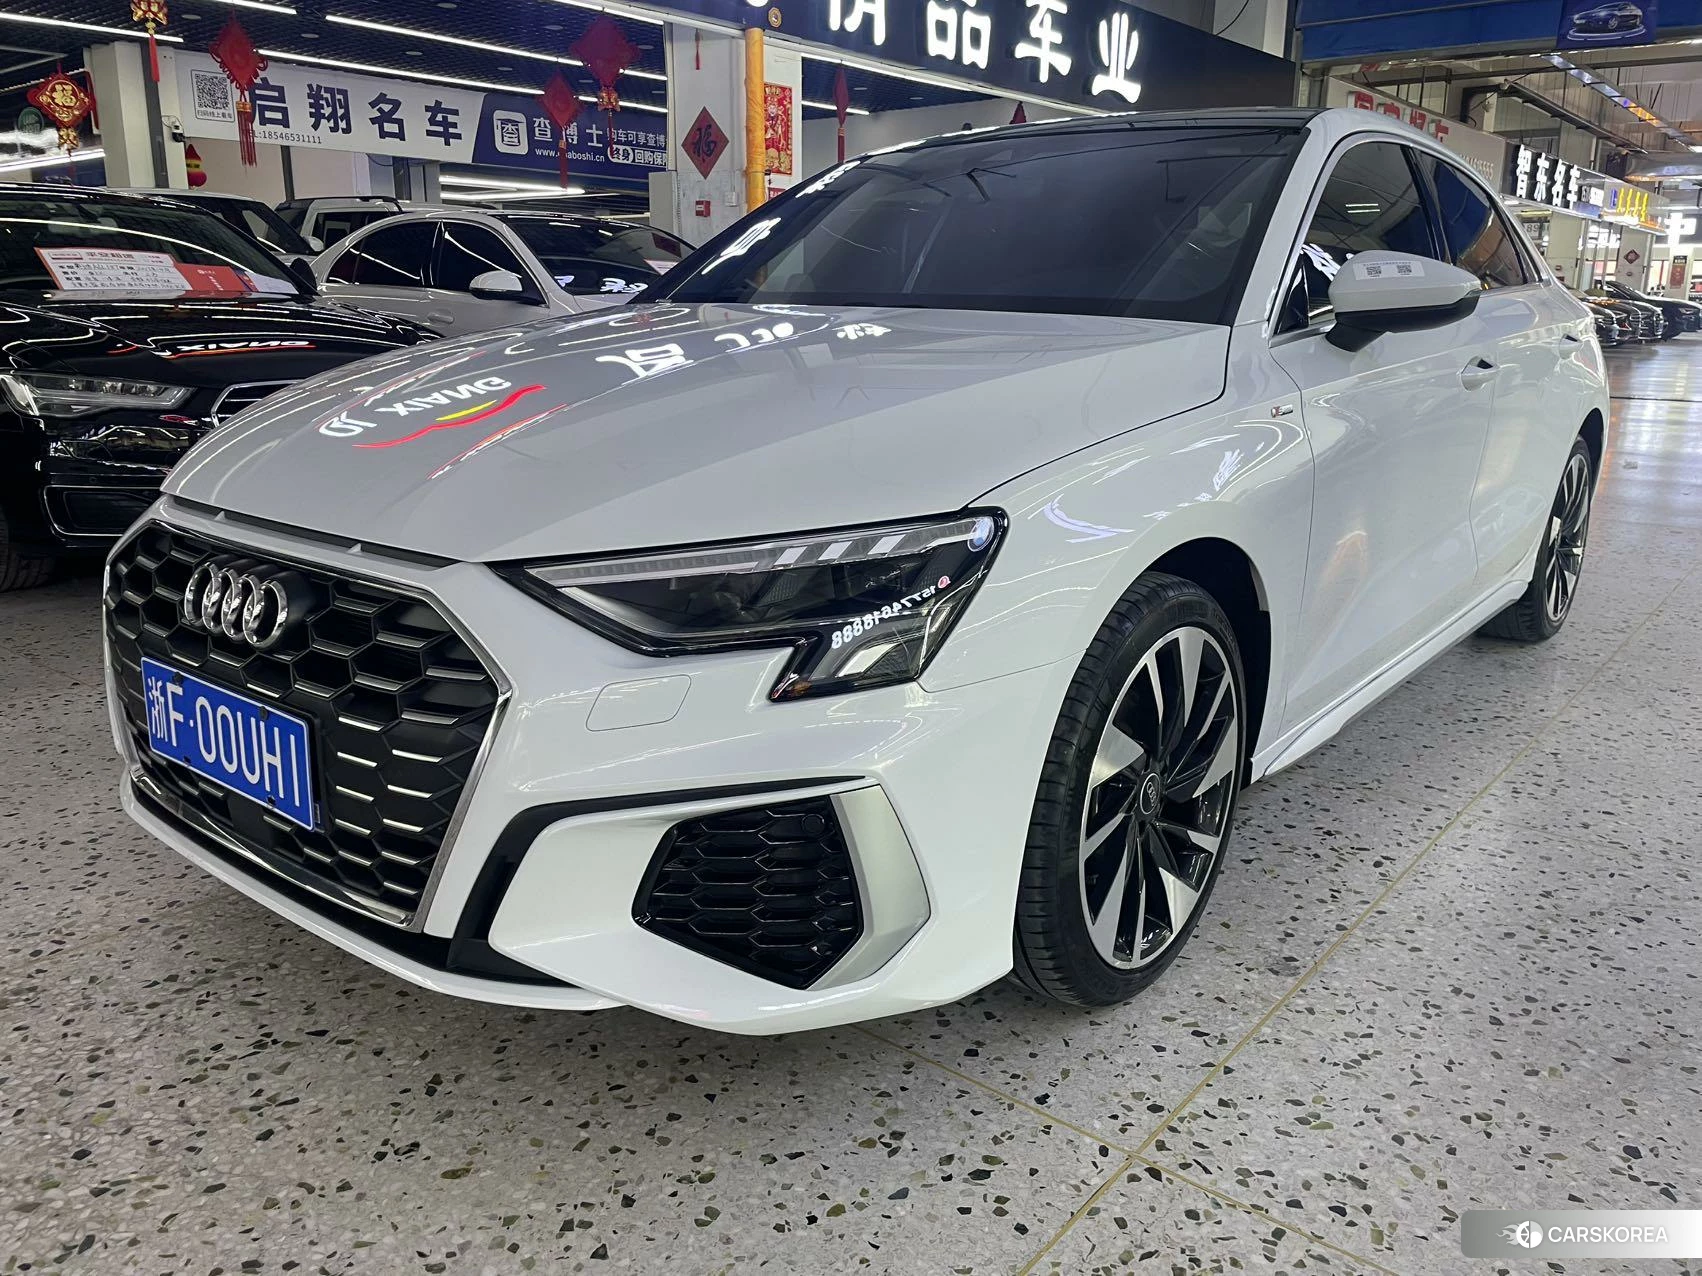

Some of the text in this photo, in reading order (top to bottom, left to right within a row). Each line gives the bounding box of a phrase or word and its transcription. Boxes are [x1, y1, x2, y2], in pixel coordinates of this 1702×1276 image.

[248, 76, 463, 146] 启翔名车
[533, 117, 603, 147] 查博士
[535, 148, 605, 163] www.aboshi.cn
